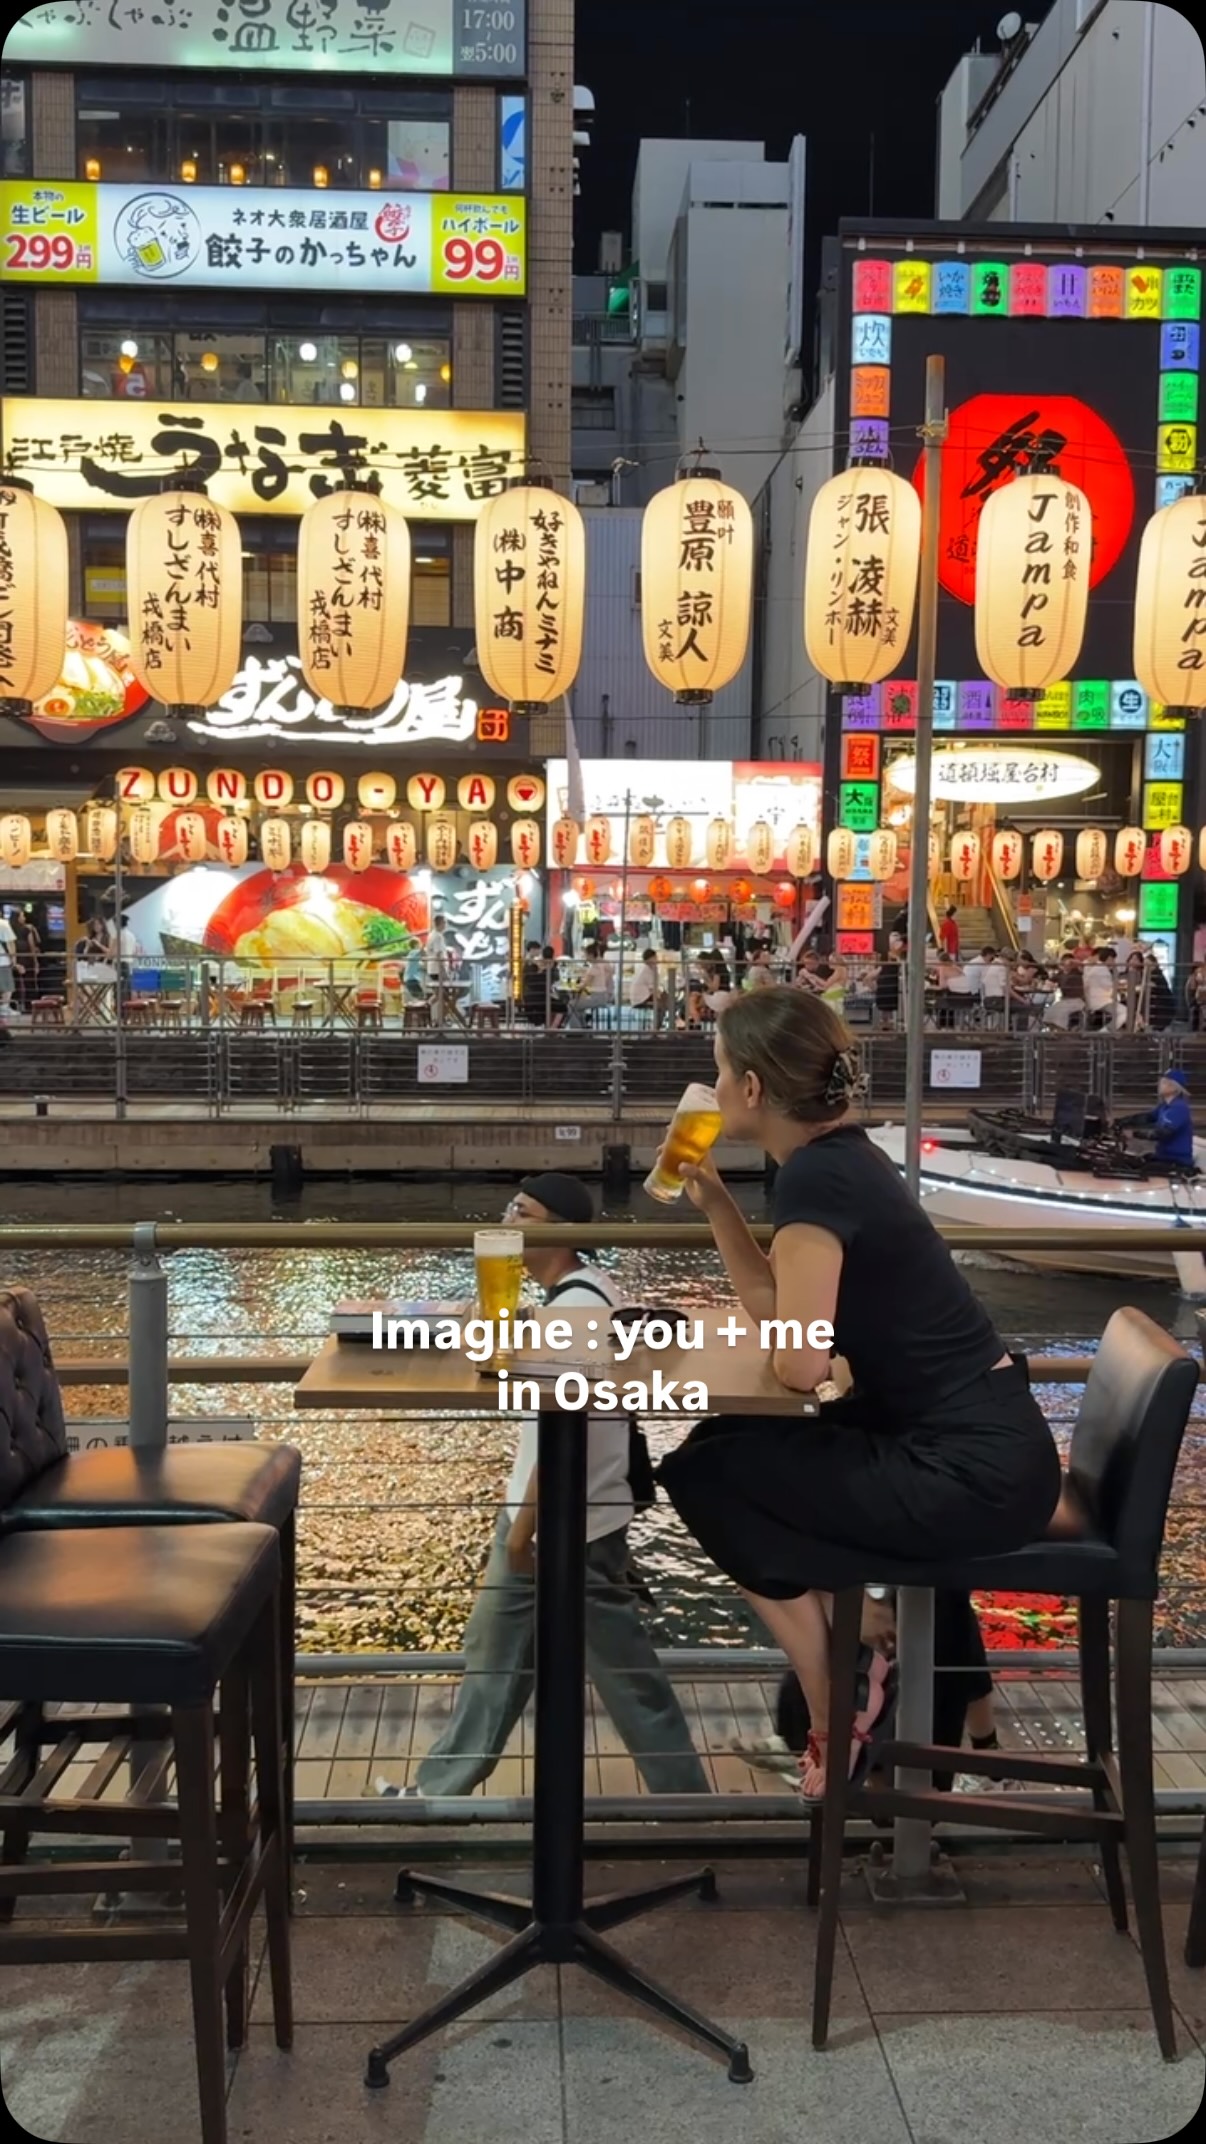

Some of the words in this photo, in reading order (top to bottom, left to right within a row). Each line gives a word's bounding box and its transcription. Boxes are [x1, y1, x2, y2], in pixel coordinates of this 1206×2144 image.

[463, 9, 515, 31] 17:00
[12, 204, 85, 224] 生ビール
[232, 209, 369, 230] ネオ大衆居酒屋
[443, 218, 520, 233] ハイボール
[205, 232, 417, 269] 餃子のかっちゃん
[10, 432, 144, 463] 江戸焼
[80, 413, 388, 501] うなぎ
[401, 444, 512, 501] 菱富
[1061, 490, 1081, 582] 創作和食
[164, 504, 192, 651] すしざんまい
[331, 508, 356, 657] すしざんまい
[529, 508, 565, 674] 好きやねんミナミ
[1017, 494, 1058, 648] Jampa
[142, 592, 164, 671] 戎橋店
[309, 590, 332, 671] 戎橋店
[119, 772, 488, 806] ZUNDO-YA
[938, 762, 1060, 785] 道頓堀屋台村
